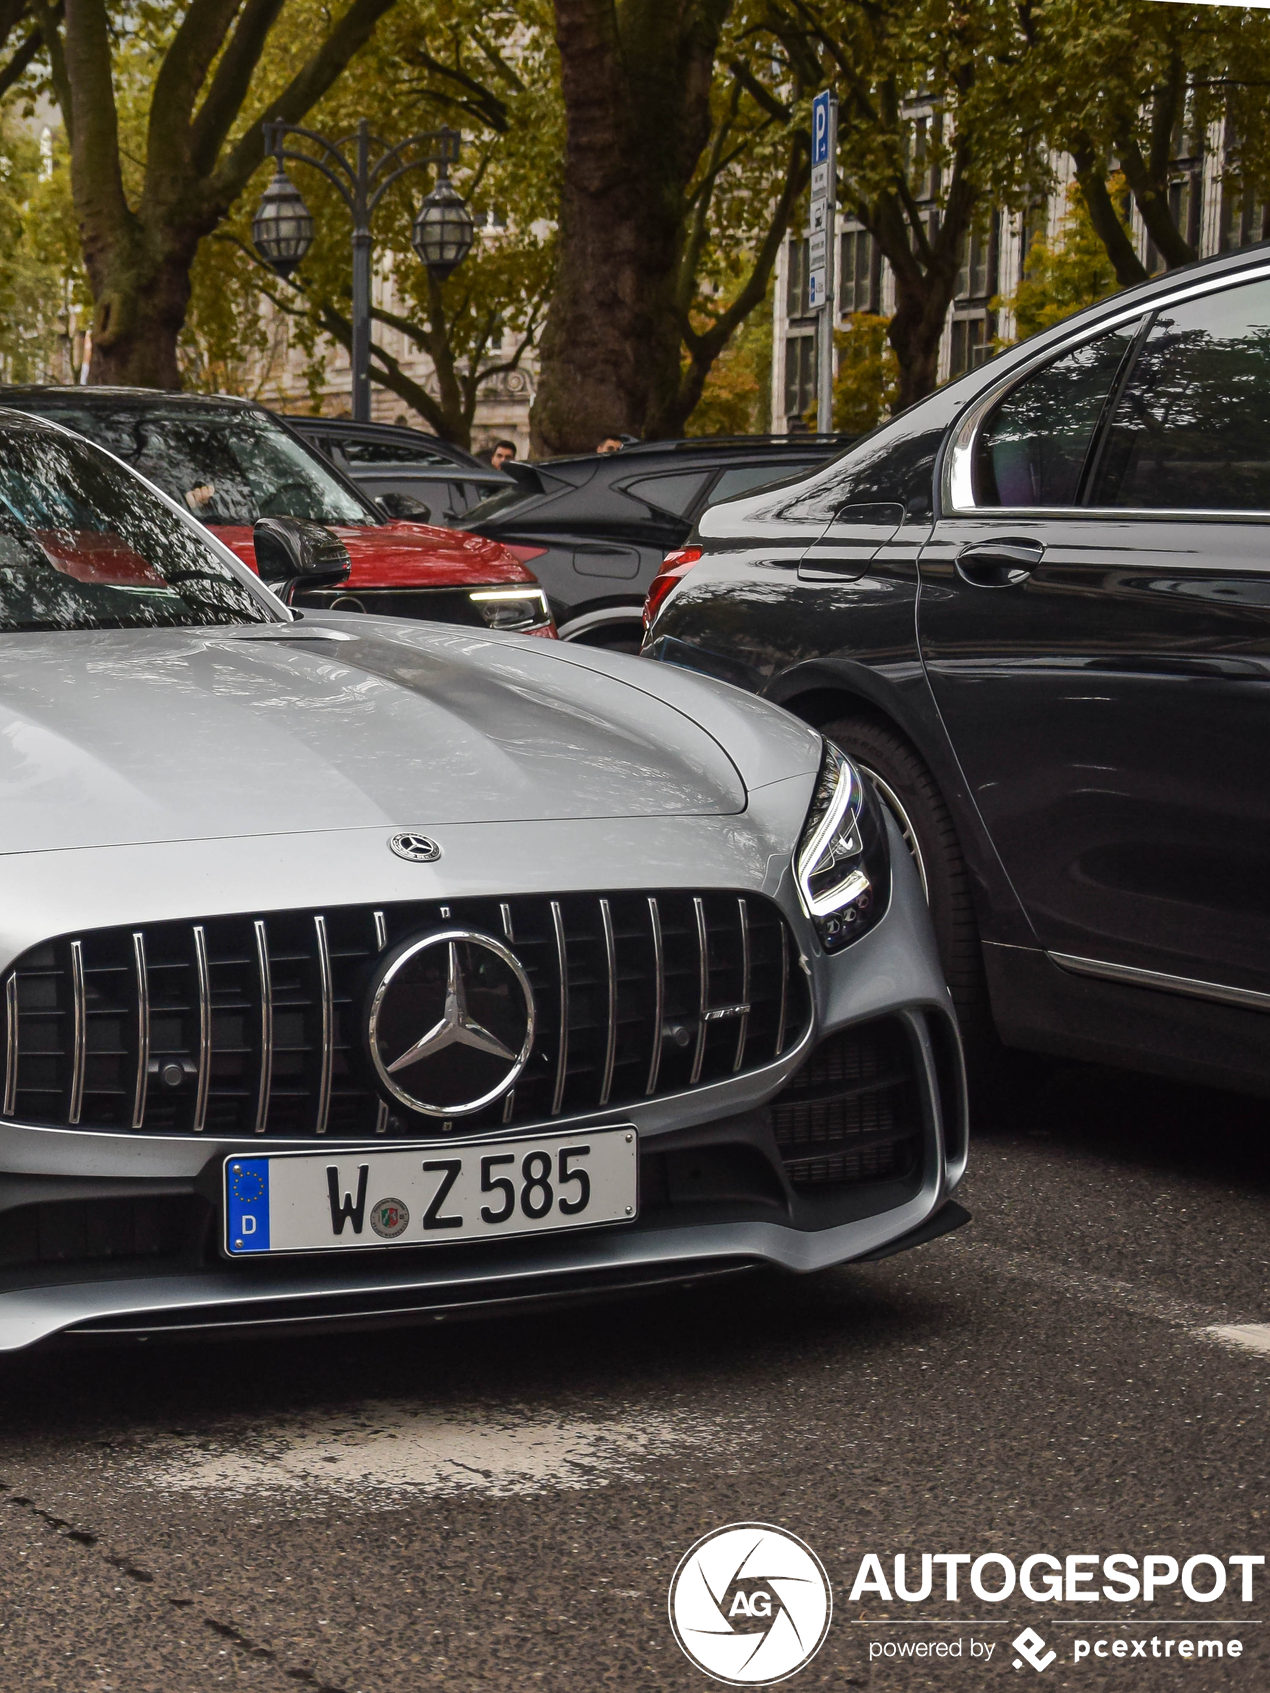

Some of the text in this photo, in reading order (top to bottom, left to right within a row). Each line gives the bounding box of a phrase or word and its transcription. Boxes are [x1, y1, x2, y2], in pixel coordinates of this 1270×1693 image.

[816, 104, 826, 162] P
[325, 1144, 592, 1235] W Z 585
[241, 1214, 257, 1235] D
